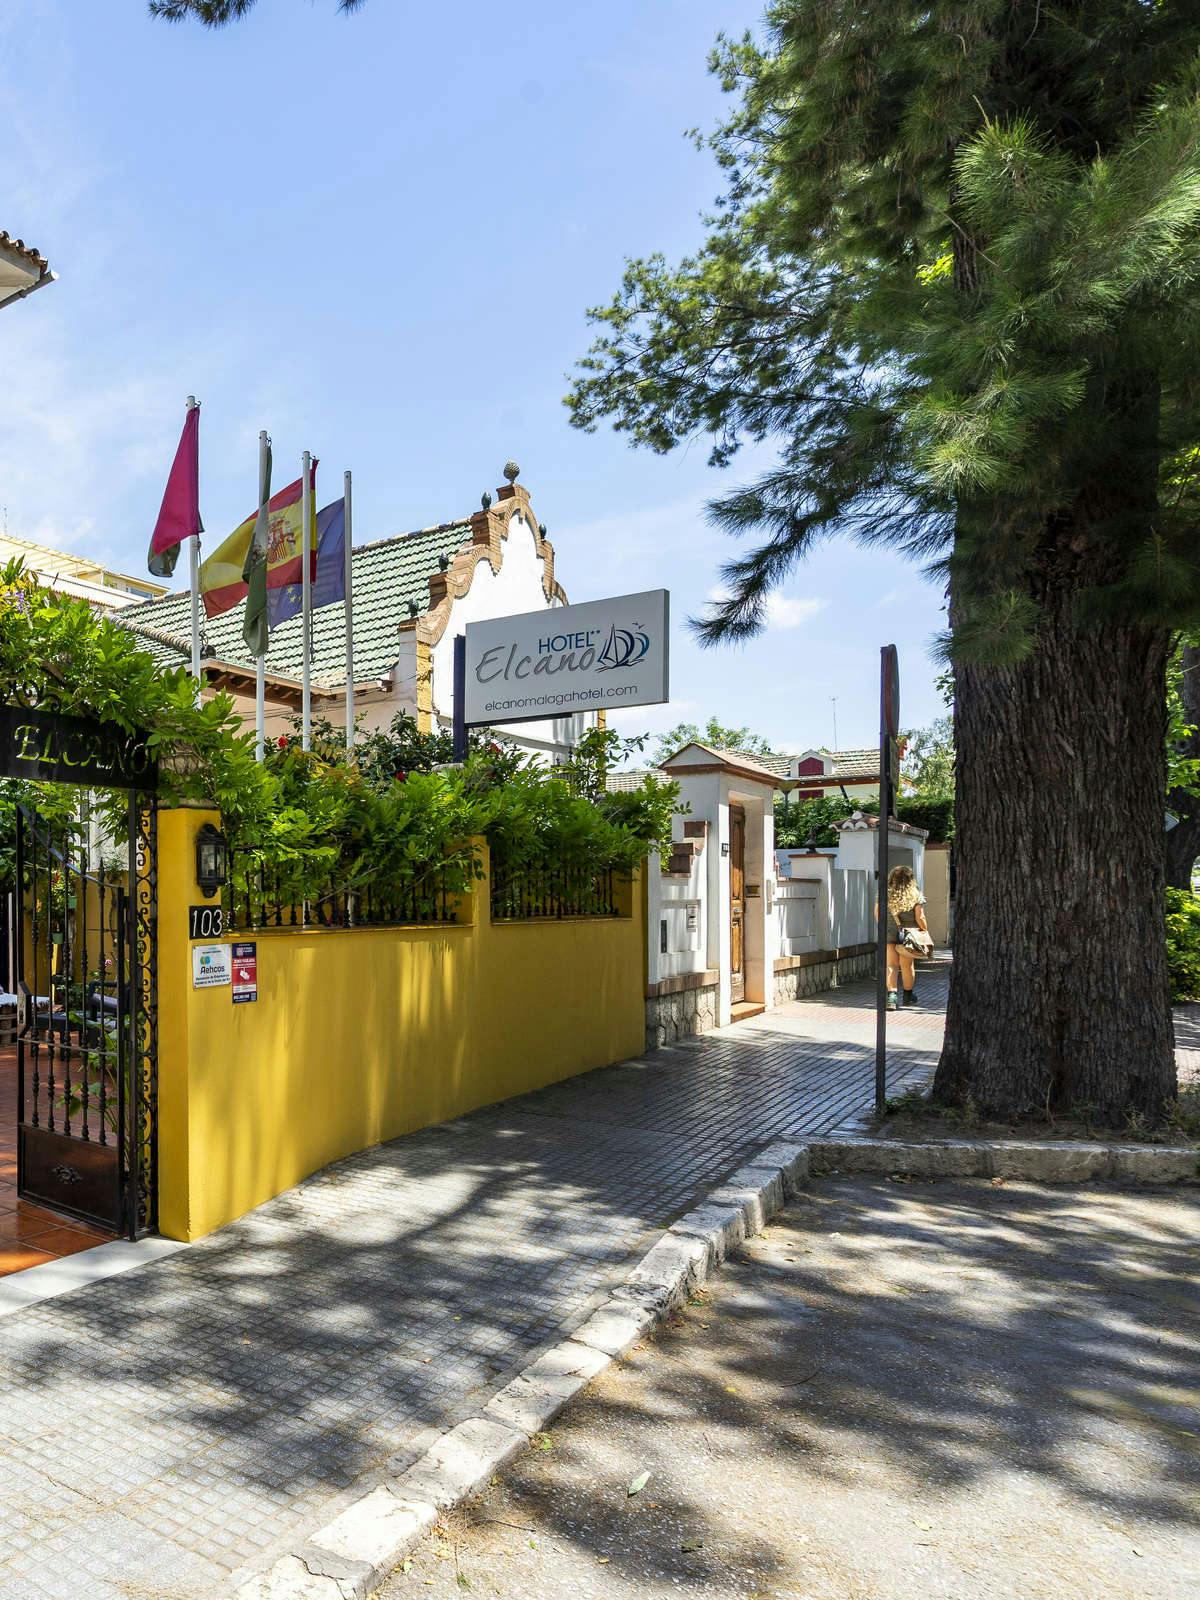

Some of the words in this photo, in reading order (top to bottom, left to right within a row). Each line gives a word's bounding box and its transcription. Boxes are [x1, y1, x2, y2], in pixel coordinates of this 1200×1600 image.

[538, 632, 596, 654] HOTEL
[475, 643, 598, 684] Elcano
[485, 685, 638, 711] elcanomalagahotel.com
[193, 909, 222, 937] 103
